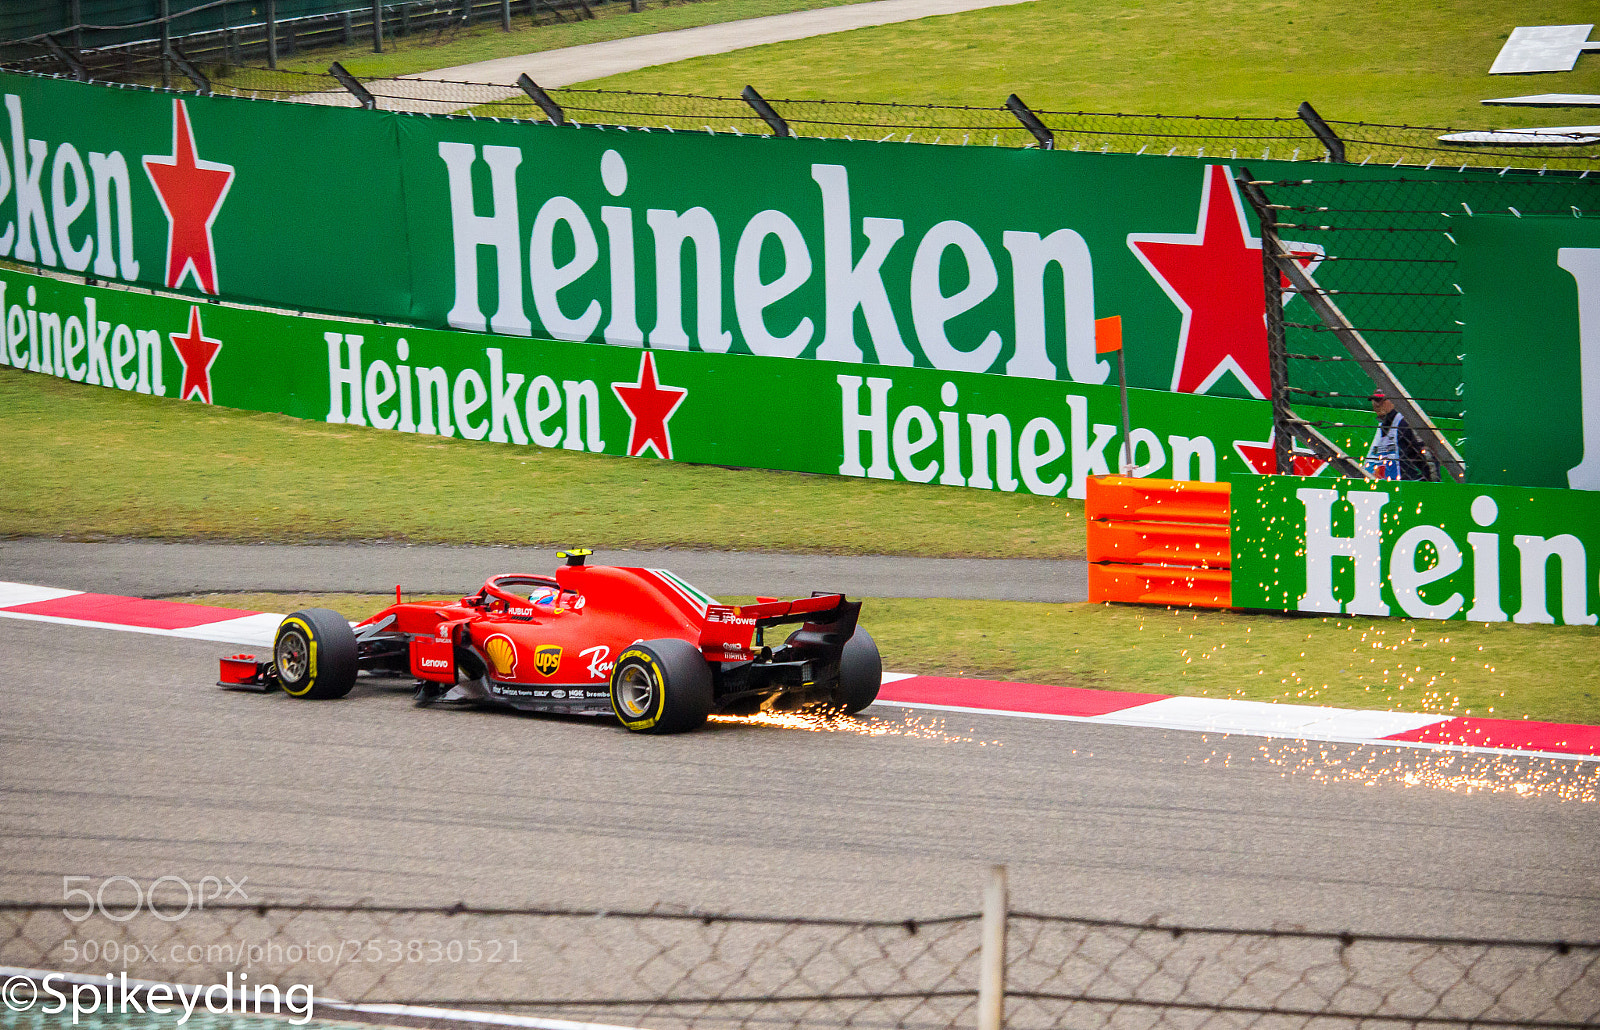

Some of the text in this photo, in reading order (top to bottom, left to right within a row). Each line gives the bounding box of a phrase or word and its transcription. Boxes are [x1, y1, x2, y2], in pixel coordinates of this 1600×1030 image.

[438, 141, 1110, 384] Heineken
[324, 331, 605, 453] Heineken
[836, 374, 1216, 500] Heineken
[508, 607, 534, 616] HUBLOT
[1296, 488, 1600, 626] Hein
[421, 657, 449, 668] Lenovo
[535, 652, 560, 673] ups
